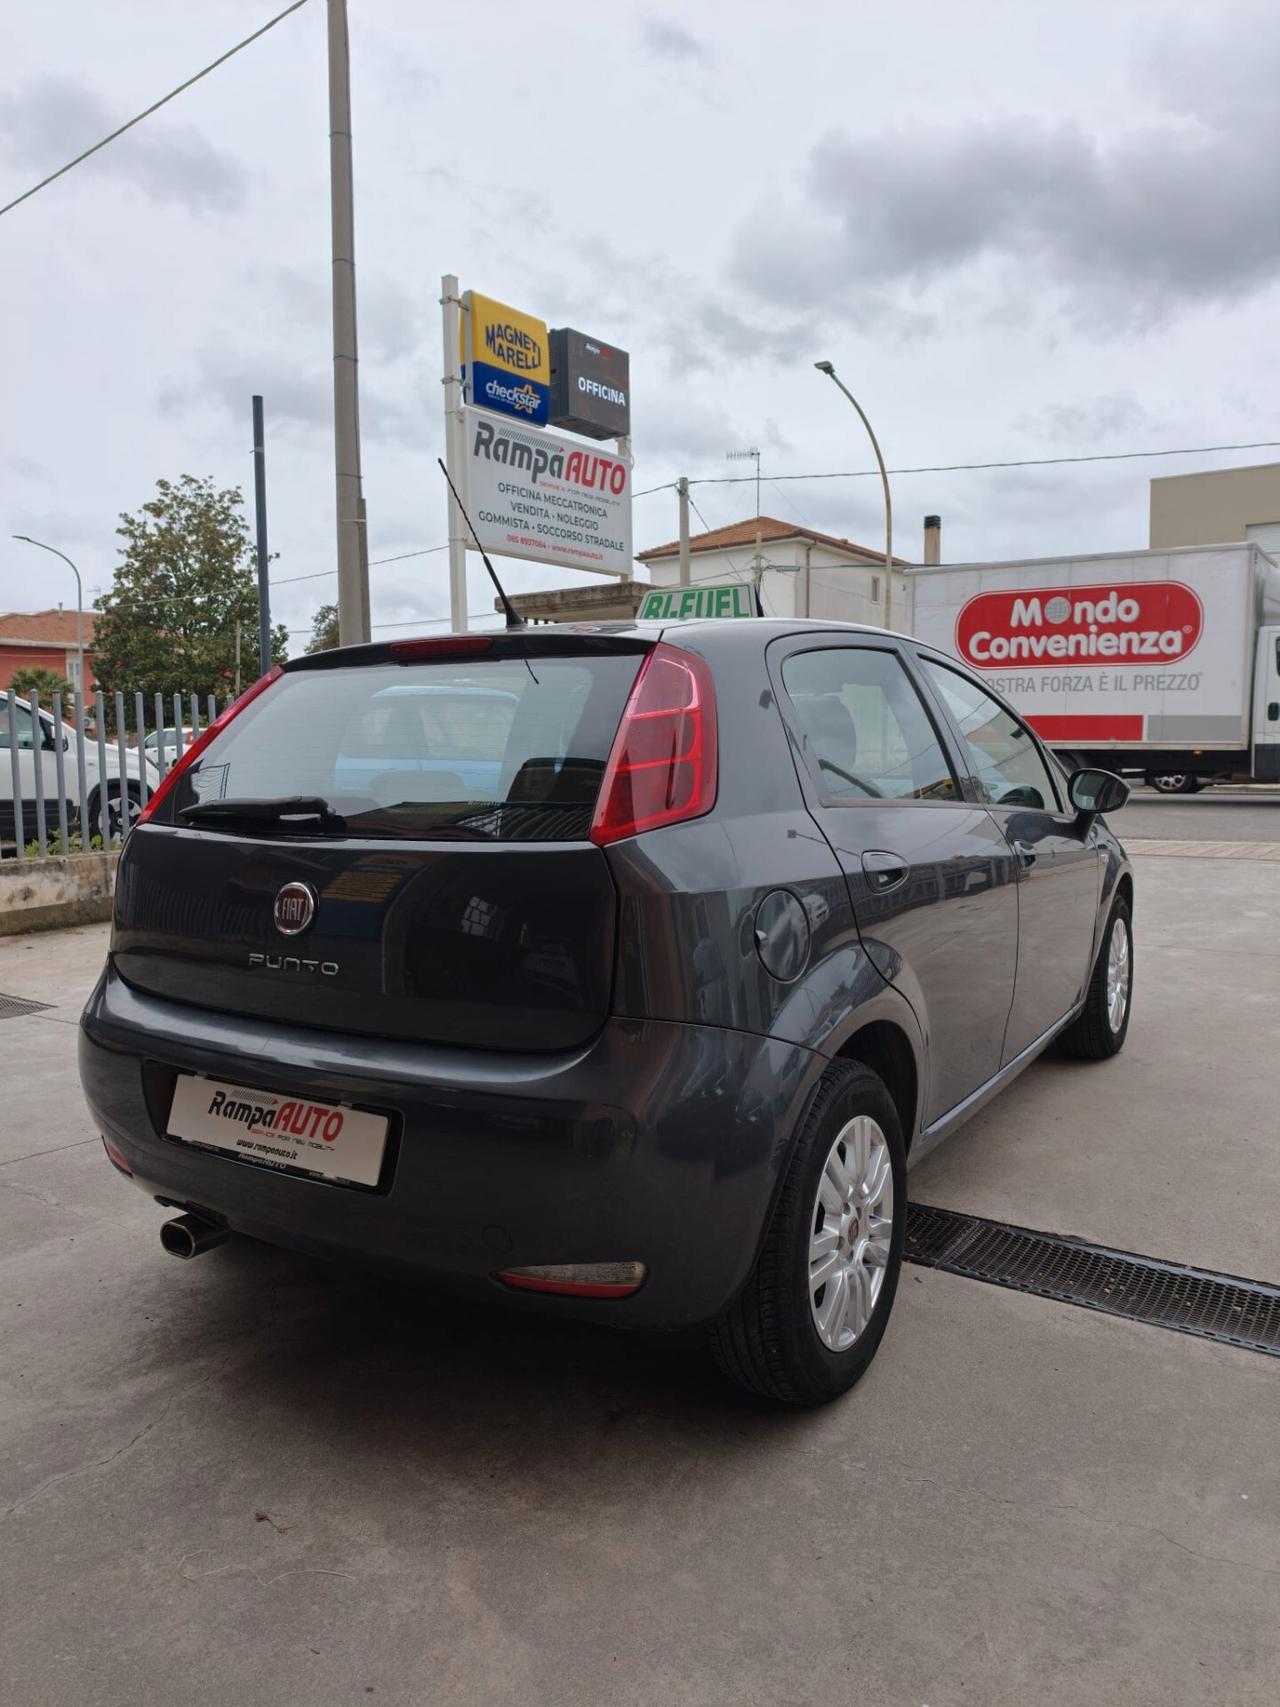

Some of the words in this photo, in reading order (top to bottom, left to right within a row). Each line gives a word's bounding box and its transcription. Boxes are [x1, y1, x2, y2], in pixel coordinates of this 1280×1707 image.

[486, 380, 541, 410] checkstar
[578, 377, 626, 406] OFFICINA
[498, 482, 541, 502] OFFICINA
[544, 493, 608, 518] MECCATRONICA
[478, 510, 530, 530] GOMMISTA
[537, 523, 583, 543] SOCCORSO
[584, 534, 624, 552] STRADALE
[511, 501, 550, 520] VENDITA
[557, 511, 599, 531] NOLEGGIO
[1010, 591, 1140, 627] Mondo
[968, 624, 1183, 661] Convenienza
[1041, 675, 1093, 693] FORZA
[1099, 671, 1108, 691] È
[1113, 675, 1128, 692] IL
[1133, 674, 1200, 692] PREZZO
[281, 897, 304, 921] FIAT
[248, 952, 340, 976] PUNTO
